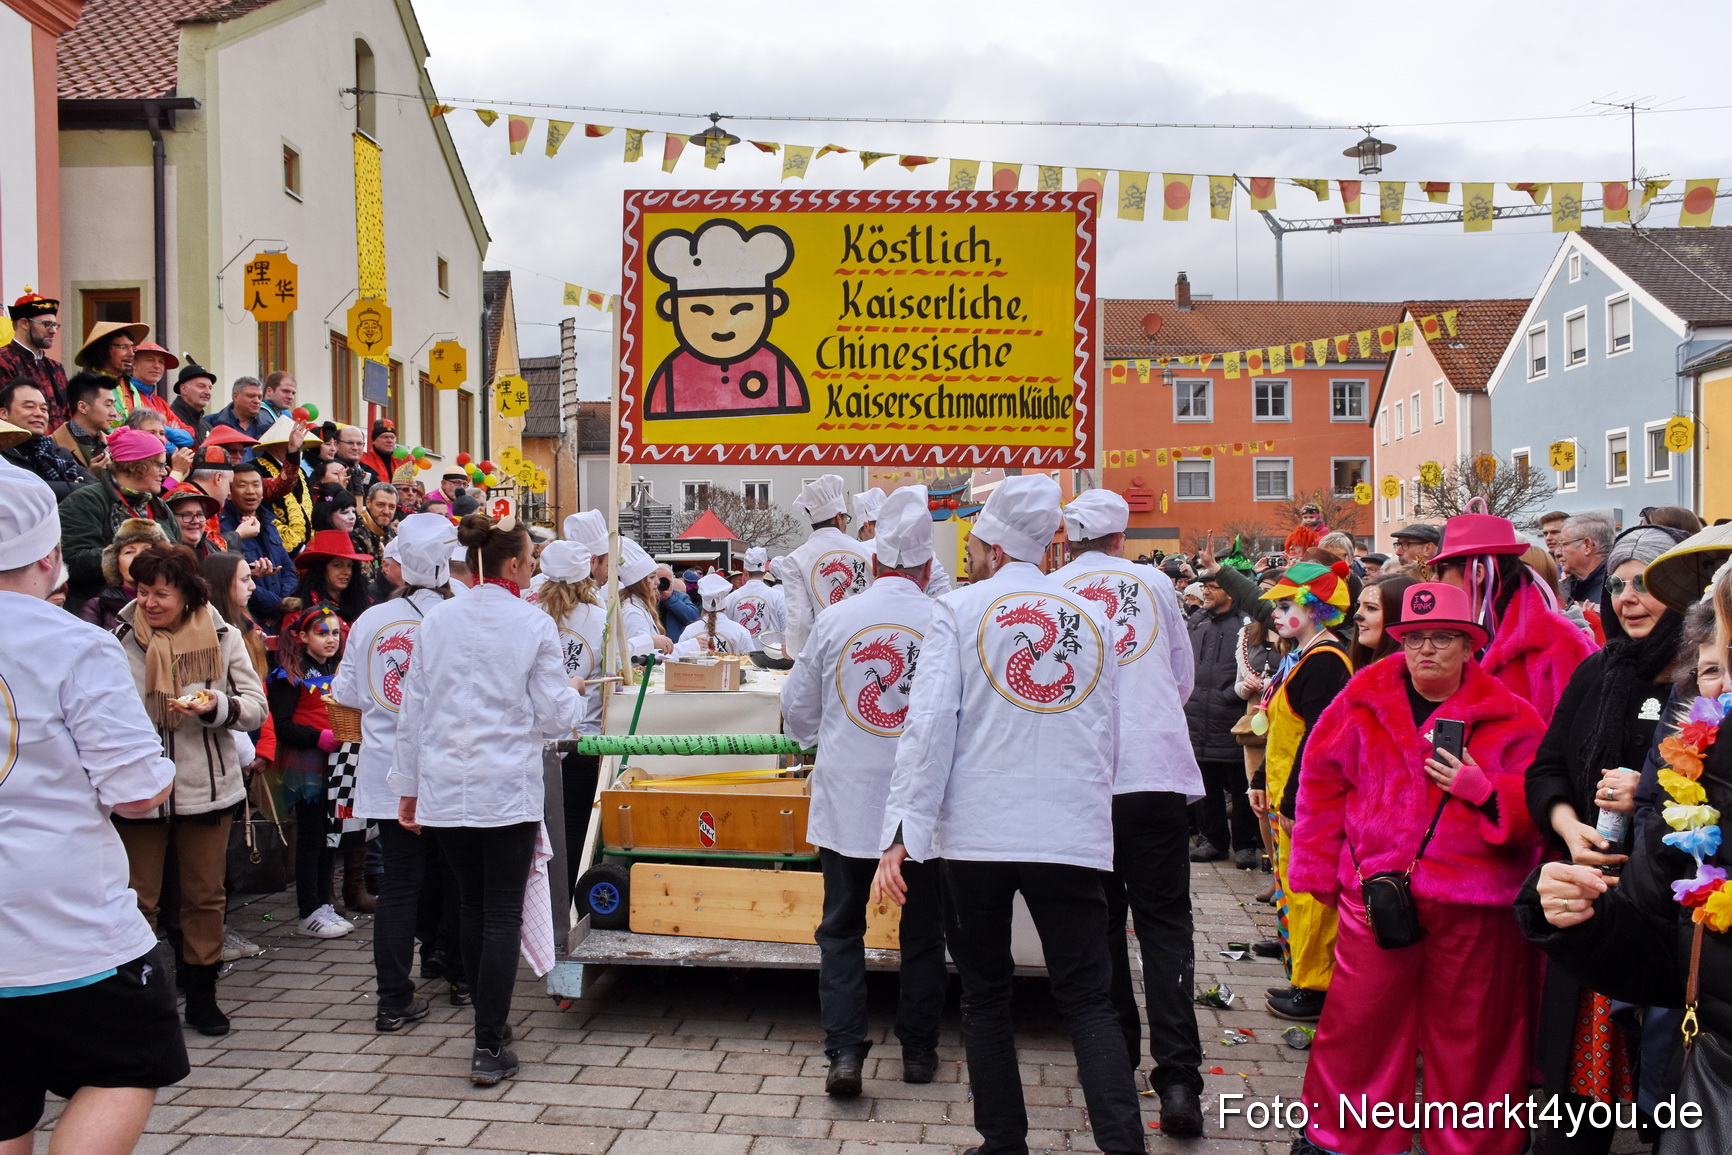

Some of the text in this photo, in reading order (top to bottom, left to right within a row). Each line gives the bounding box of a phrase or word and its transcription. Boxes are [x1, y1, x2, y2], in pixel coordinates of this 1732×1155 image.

[840, 222, 1002, 268] Köstlich,
[836, 279, 1029, 323] Kaiserliche,
[815, 334, 1013, 371] Chinesische
[1117, 580, 1141, 617] 初春
[1057, 607, 1082, 655] 初春
[699, 820, 715, 840] PUKY
